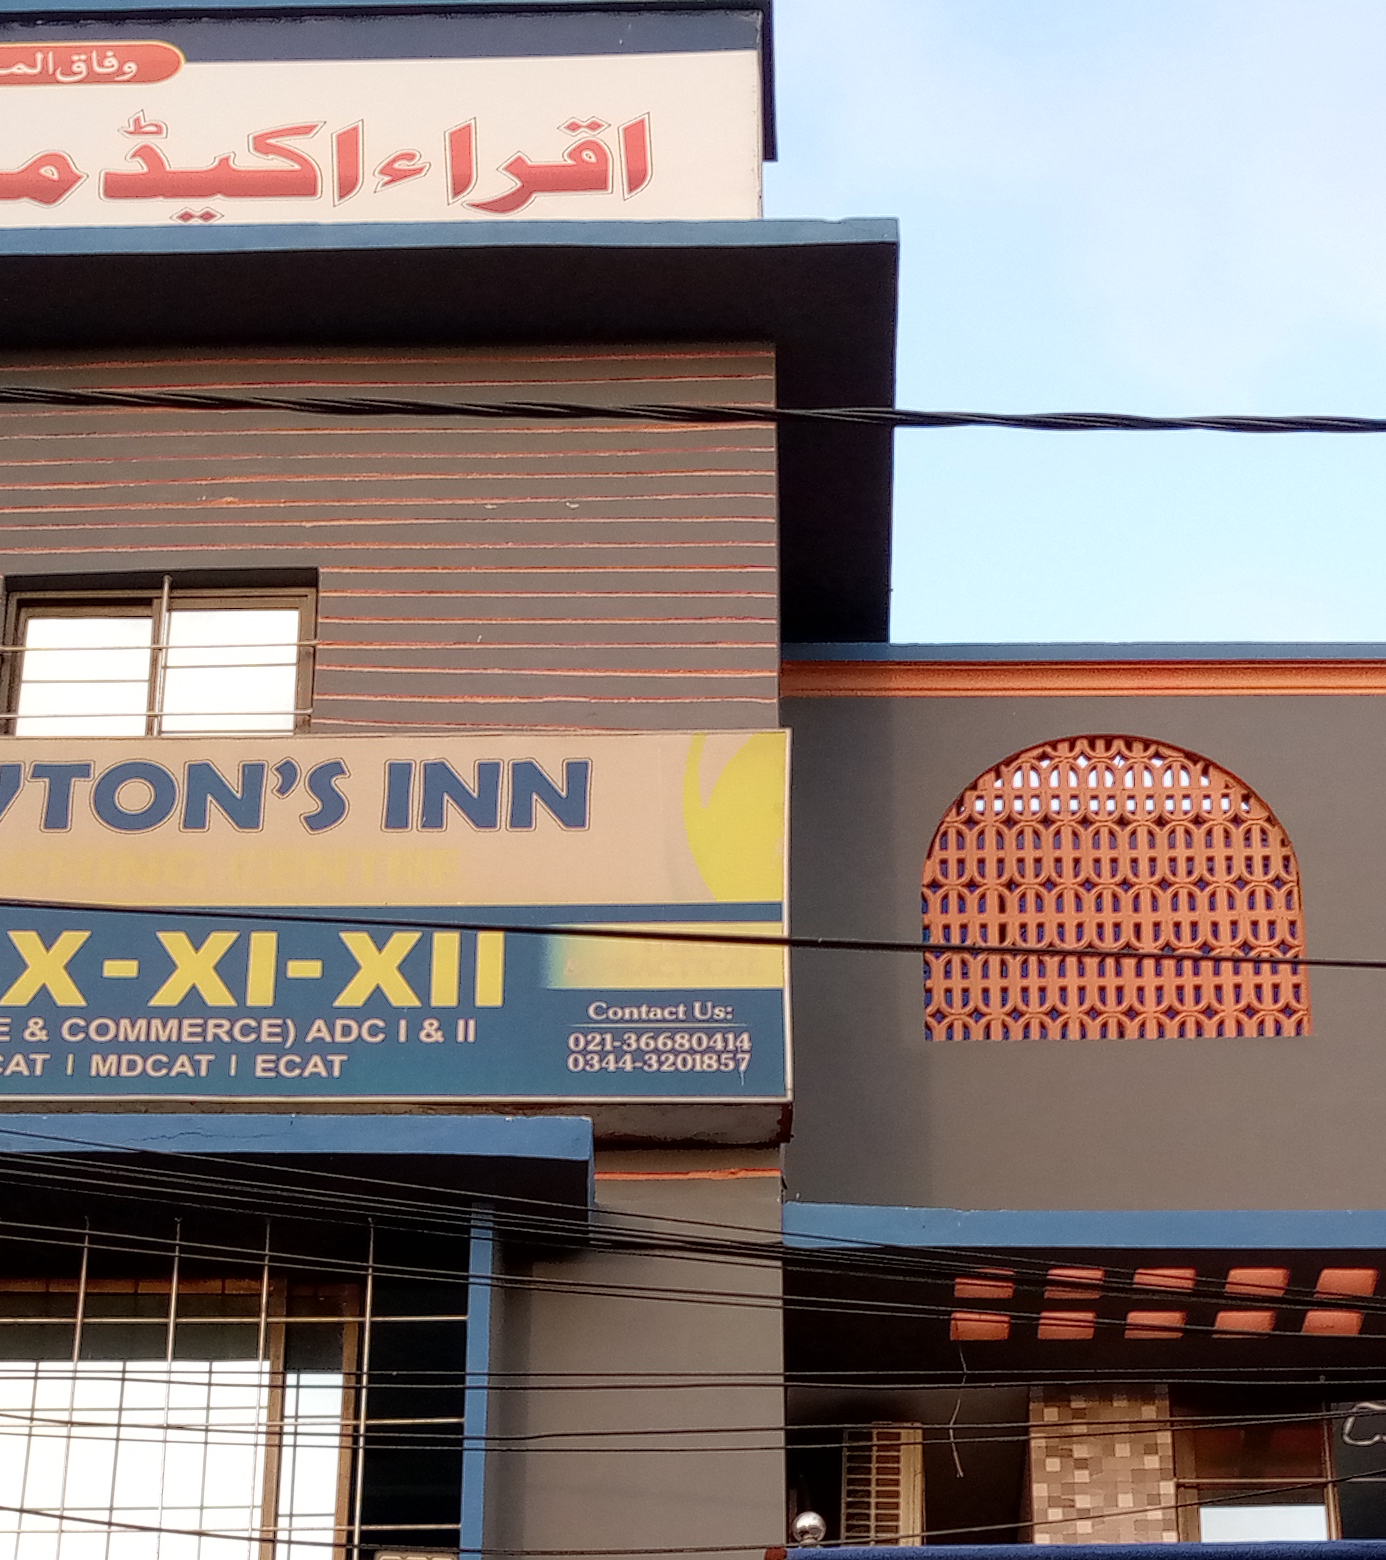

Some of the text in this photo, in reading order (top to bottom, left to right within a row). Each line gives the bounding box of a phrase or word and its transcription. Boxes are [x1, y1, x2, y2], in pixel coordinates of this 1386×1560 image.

[380, 756, 594, 833] INN
[587, 999, 734, 1022] Contact Us:
[22, 1018, 49, 1043] &
[60, 1016, 297, 1050] COMMERCE)
[304, 1018, 386, 1044] ADC
[418, 1018, 446, 1044] &
[566, 1030, 753, 1053] 021-36680414
[89, 1053, 217, 1078] MDCAT
[254, 1053, 349, 1079] ECAT
[566, 1051, 753, 1074] 0344-3201857
